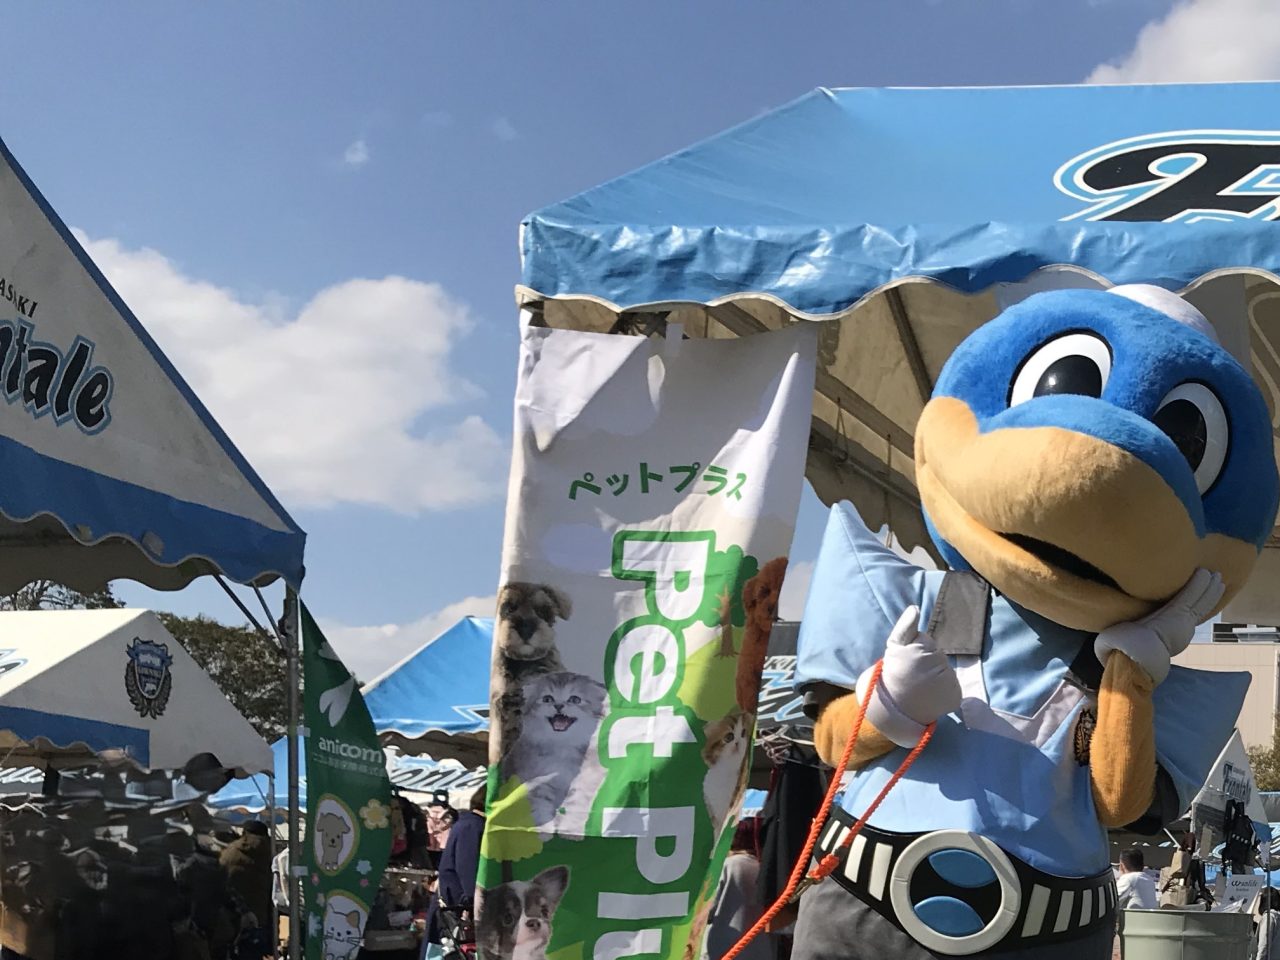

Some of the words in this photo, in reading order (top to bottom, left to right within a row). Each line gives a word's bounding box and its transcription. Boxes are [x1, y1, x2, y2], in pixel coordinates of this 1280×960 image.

[568, 461, 748, 502] ペットプラス
[602, 532, 714, 770] Pet
[318, 737, 383, 763] anicom
